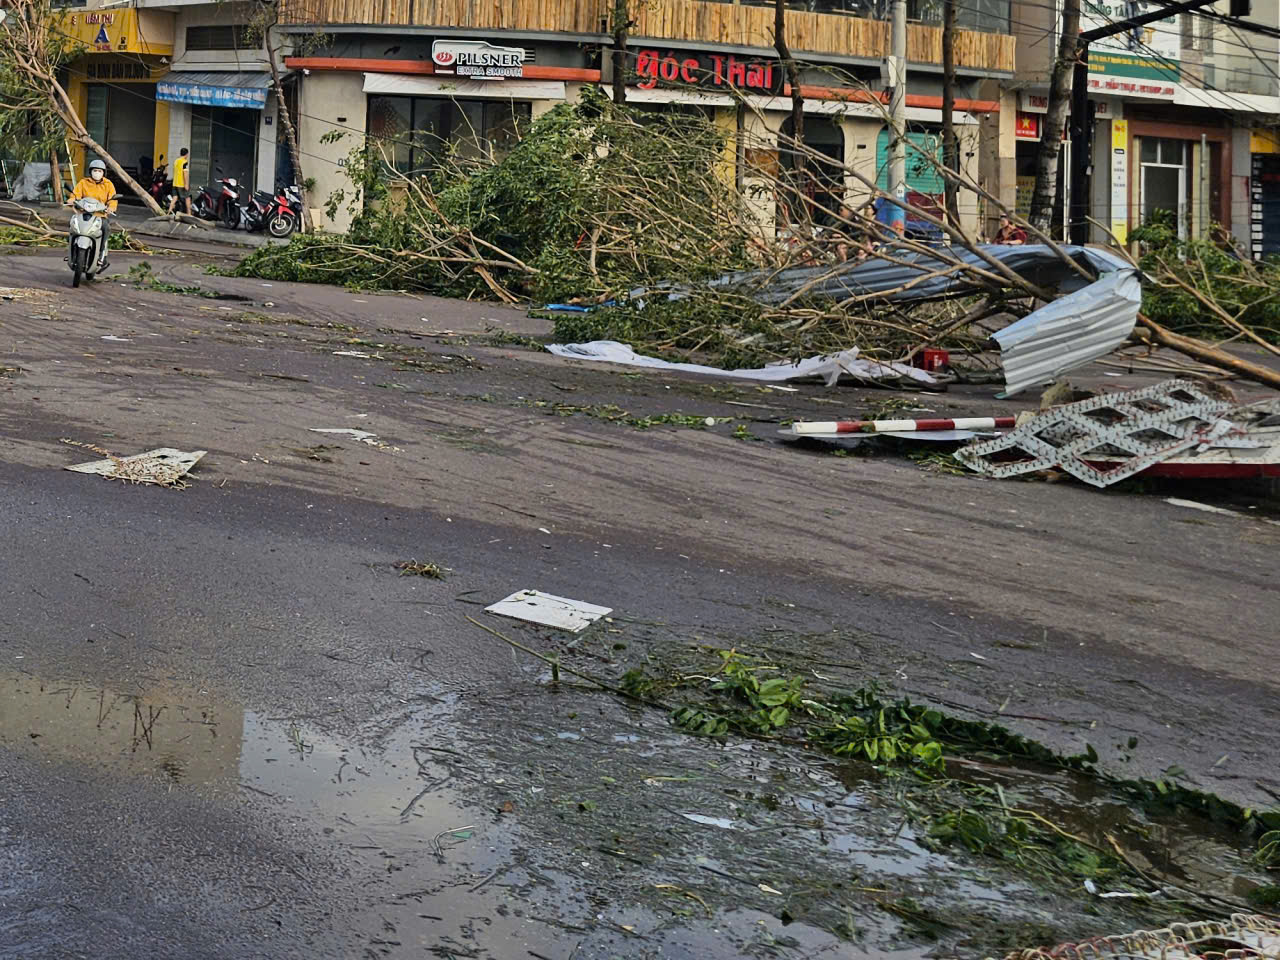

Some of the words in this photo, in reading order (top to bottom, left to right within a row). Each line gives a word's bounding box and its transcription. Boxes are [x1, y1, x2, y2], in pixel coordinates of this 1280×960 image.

[457, 52, 522, 67] PILSNER
[457, 66, 485, 76] EXTRA
[486, 67, 522, 77] SMOOTH
